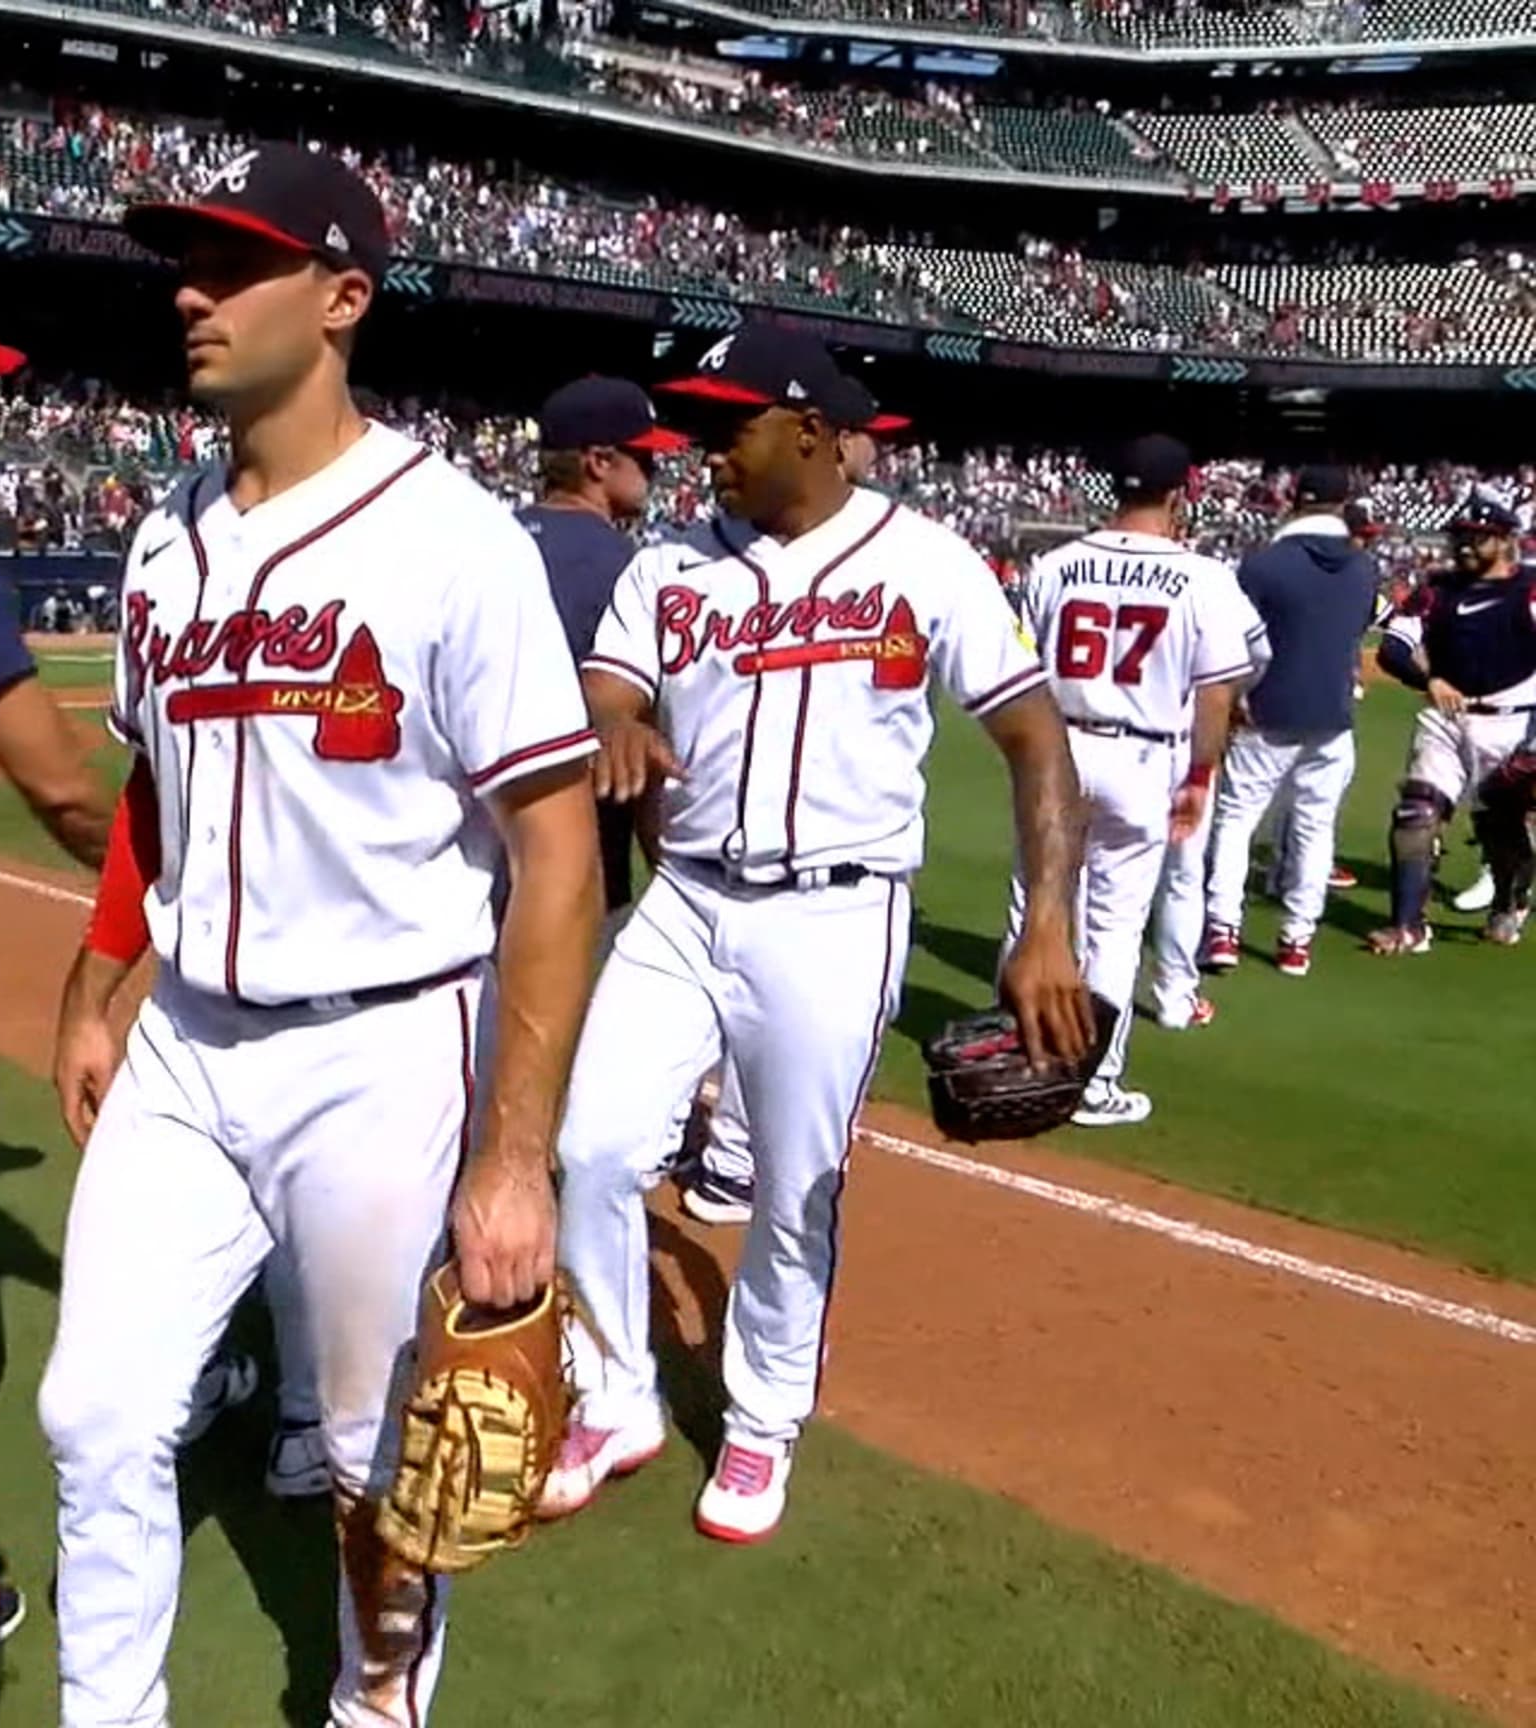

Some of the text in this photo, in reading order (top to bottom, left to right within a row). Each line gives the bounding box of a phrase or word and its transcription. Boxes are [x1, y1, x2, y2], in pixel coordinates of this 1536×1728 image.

[1059, 558, 1189, 598] WILLIAMS
[656, 582, 885, 675] Braves
[1056, 597, 1170, 687] 67
